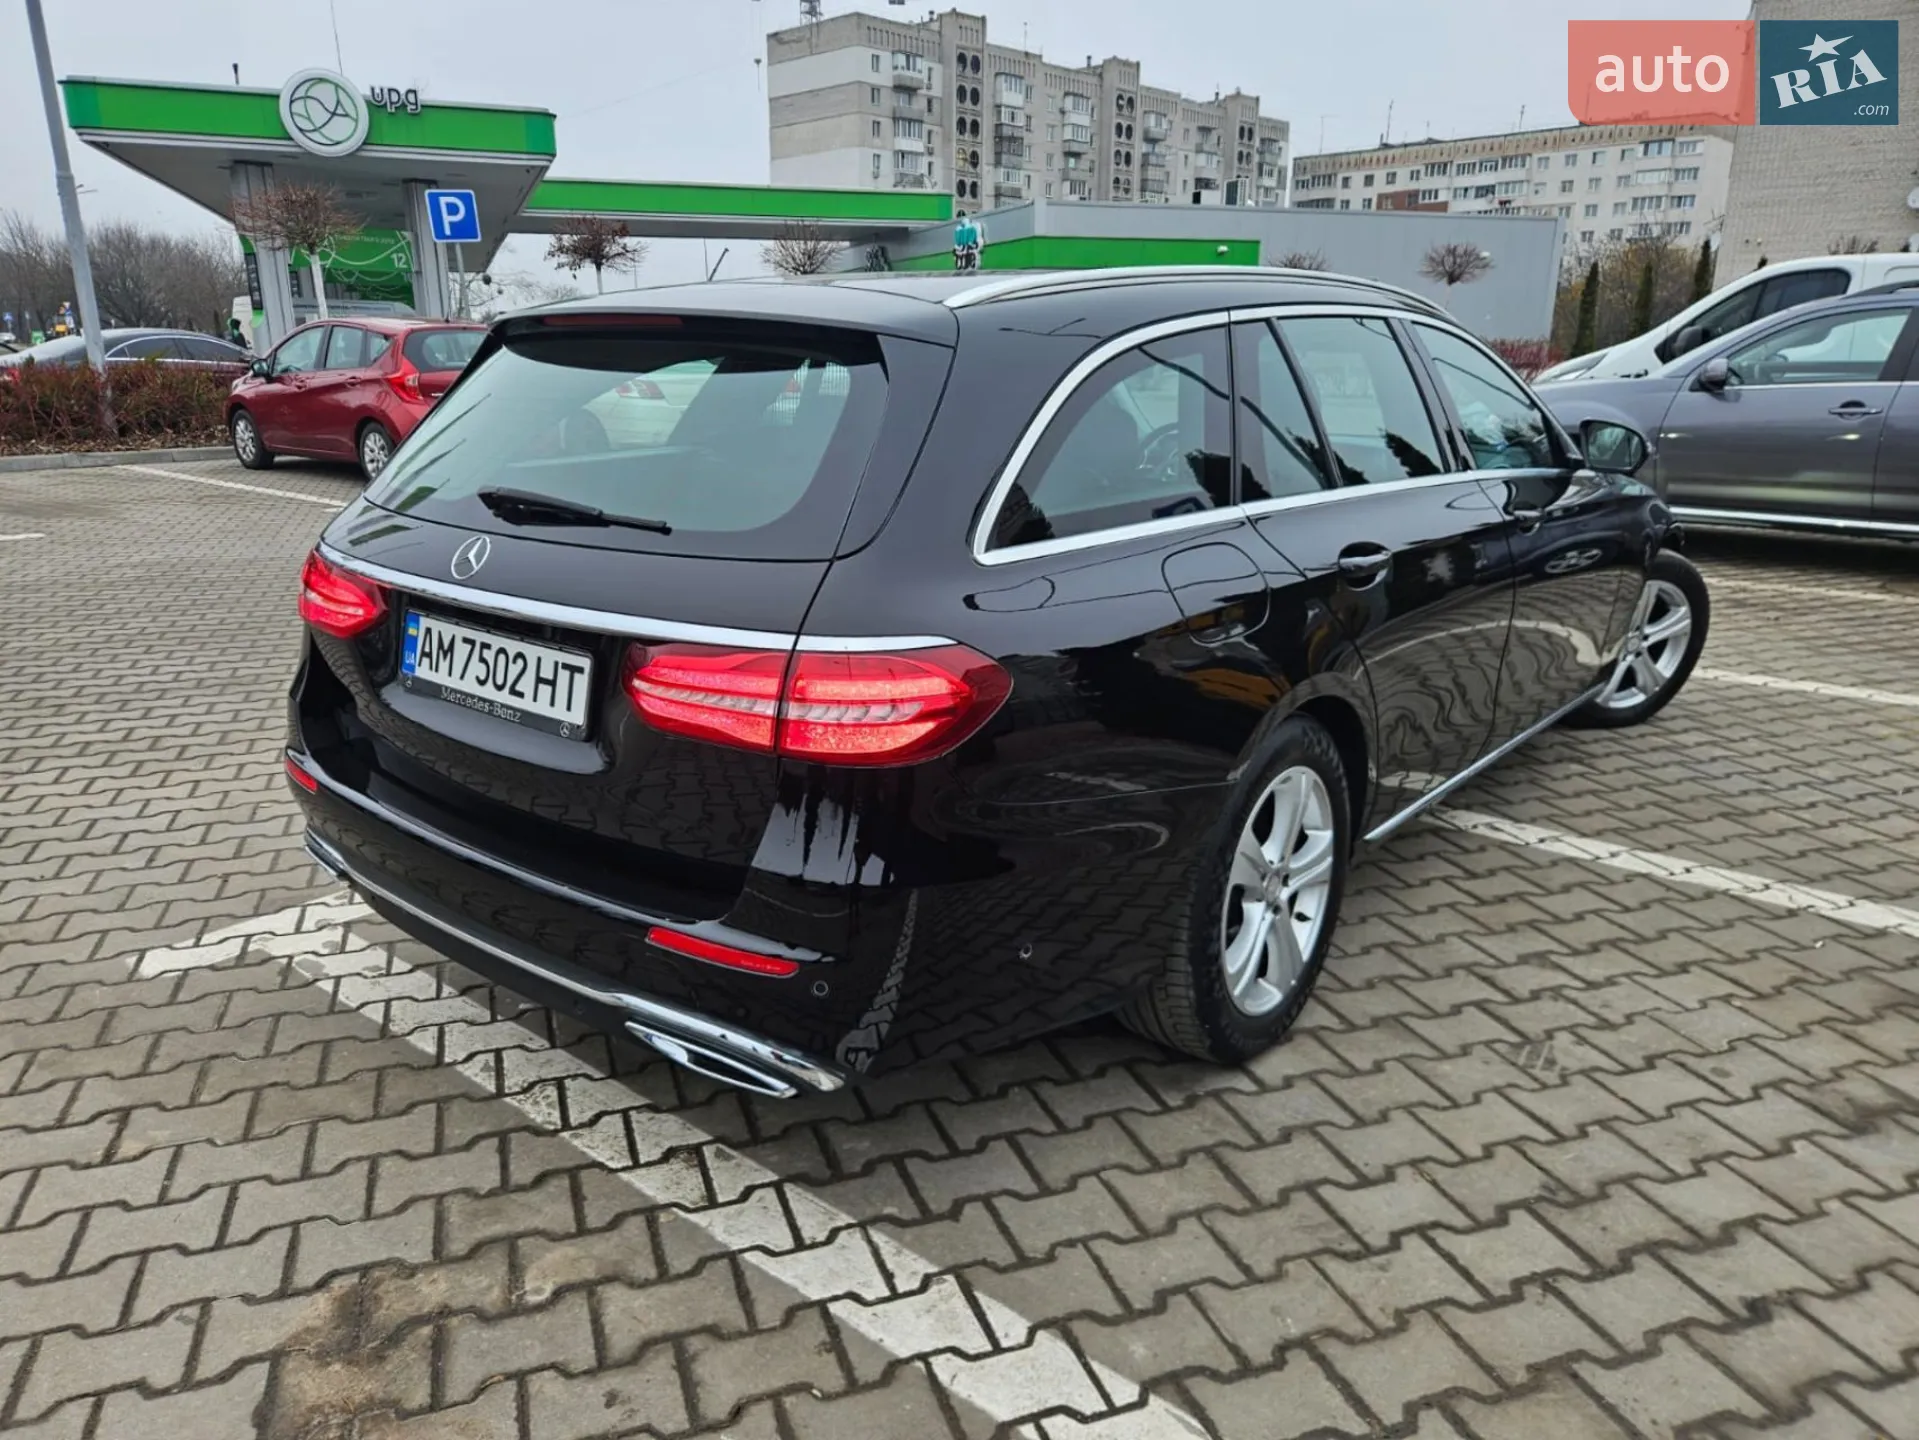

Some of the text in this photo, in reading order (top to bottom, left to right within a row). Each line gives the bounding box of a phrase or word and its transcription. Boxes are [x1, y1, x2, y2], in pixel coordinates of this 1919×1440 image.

[370, 86, 419, 112] upg
[438, 196, 465, 236] P
[390, 253, 408, 268] 12
[404, 651, 415, 664] UA
[441, 686, 522, 723] Mercedes-Benz
